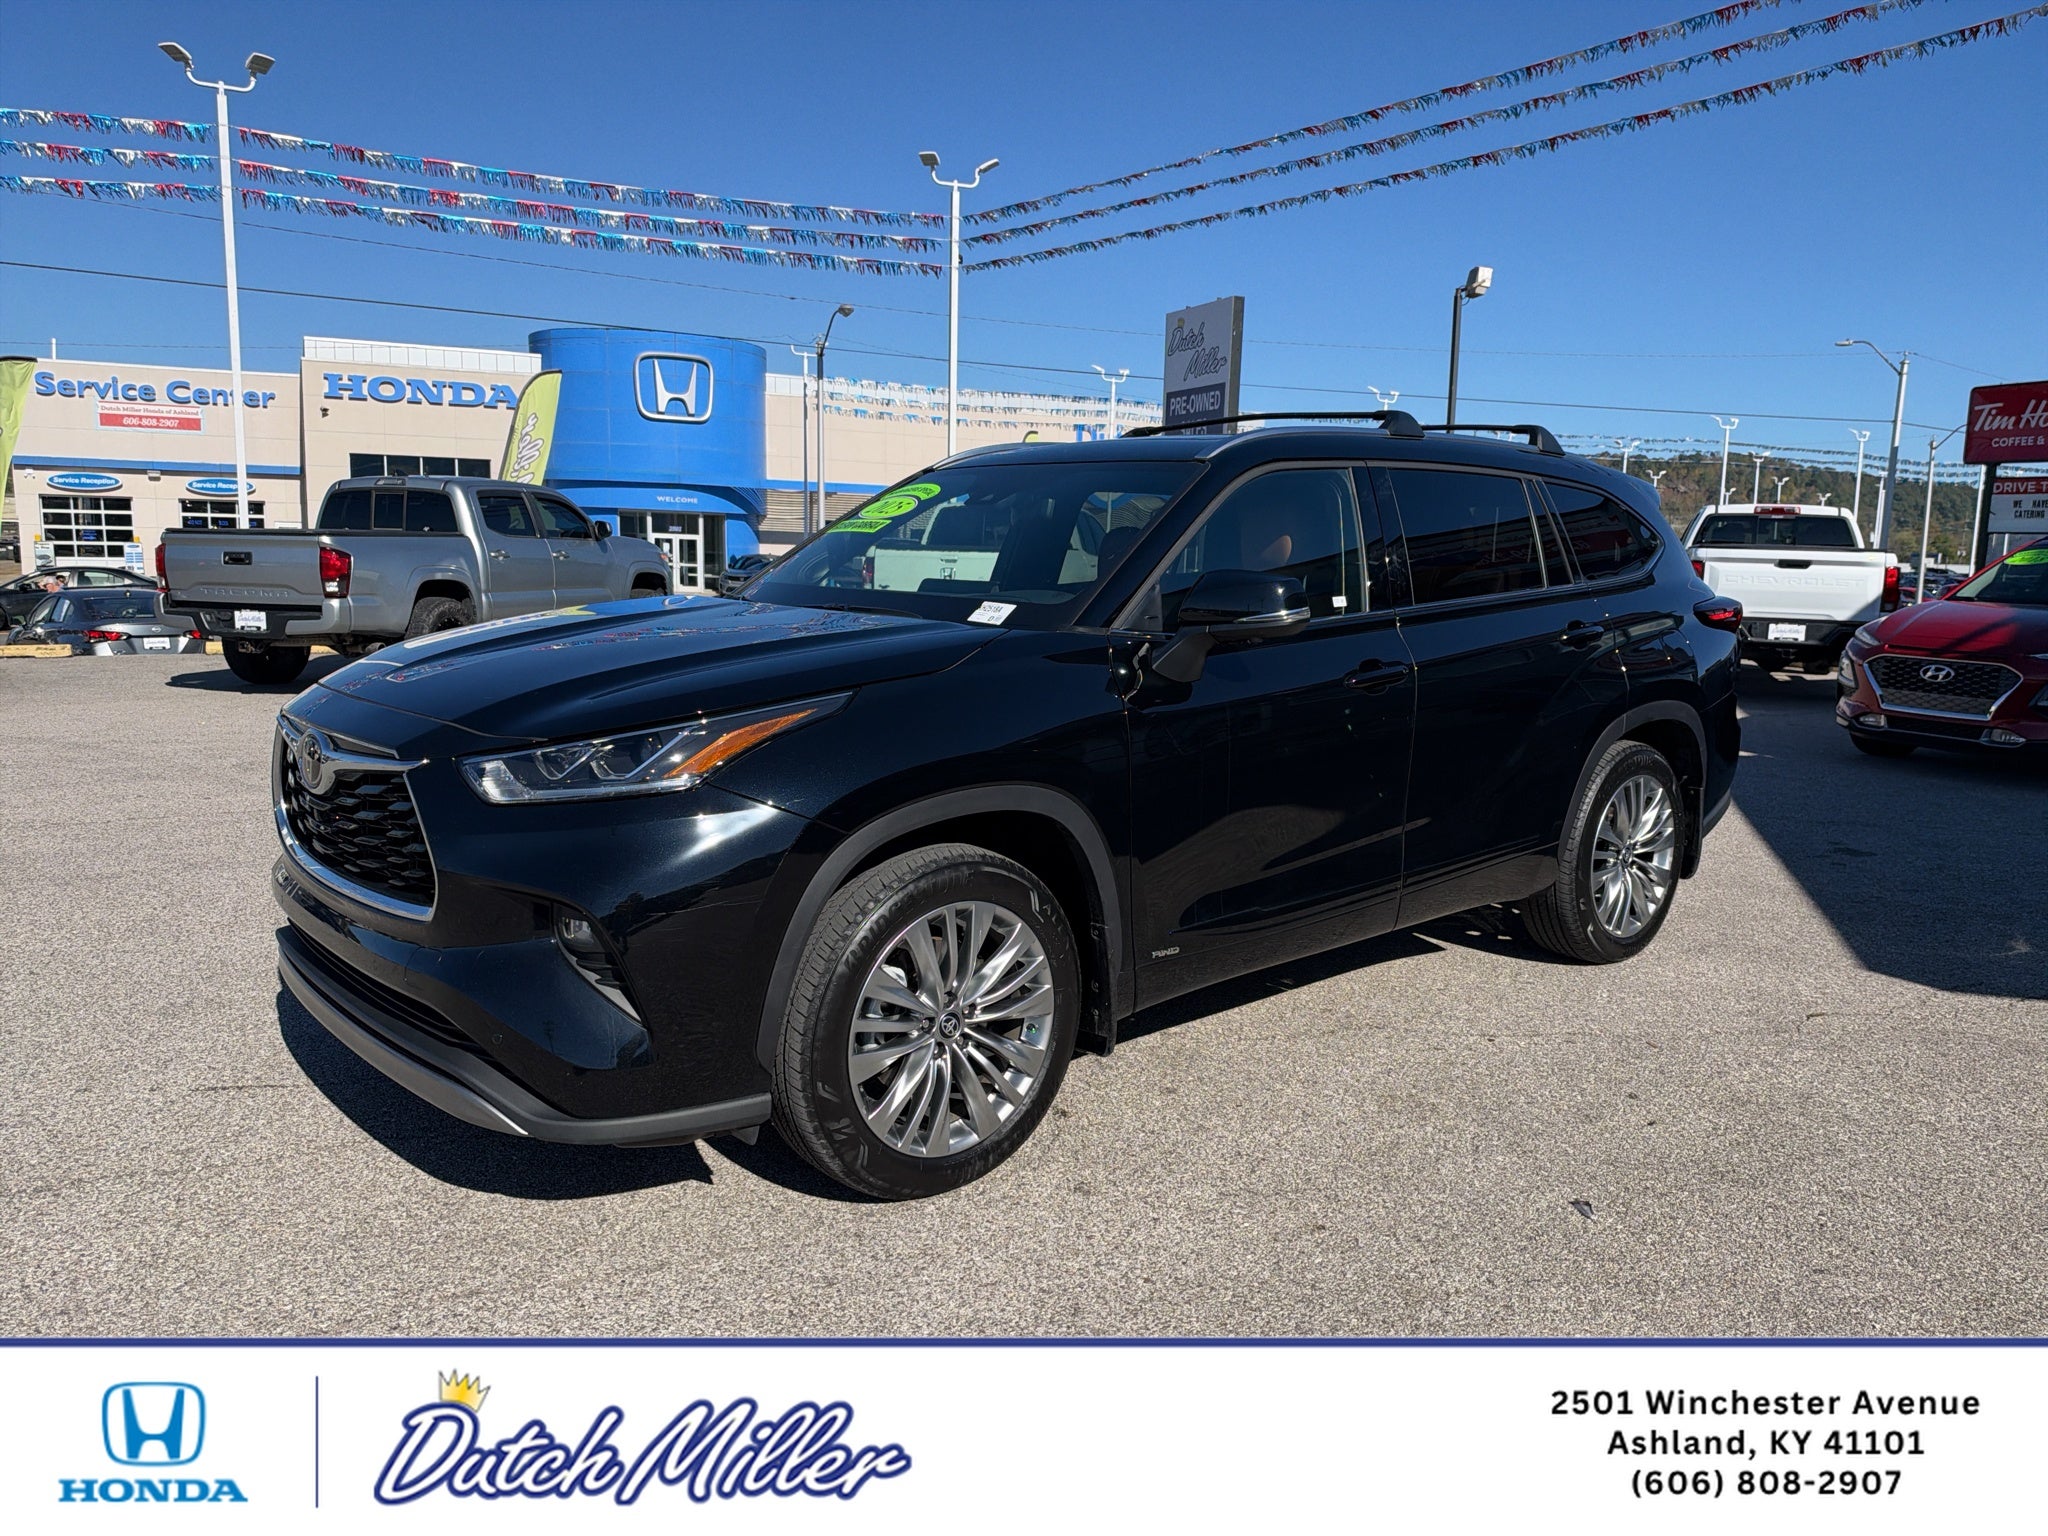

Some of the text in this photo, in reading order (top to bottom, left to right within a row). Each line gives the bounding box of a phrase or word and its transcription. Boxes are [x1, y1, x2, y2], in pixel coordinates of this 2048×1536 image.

[1168, 321, 1205, 357] Dutch
[1184, 346, 1228, 382] Miller
[34, 371, 276, 408] Service Cener
[323, 372, 519, 410] HONDA
[1169, 390, 1221, 417] PRE-OWNED
[123, 416, 179, 428] 606-808-2907
[1974, 402, 2016, 432] Tim
[1991, 435, 2045, 448] COFFEE &
[1993, 481, 2037, 493] DRIVE
[656, 495, 698, 504] WELCOME
[2013, 500, 2022, 508] WE
[2014, 510, 2046, 519] CATERING
[1725, 575, 1865, 587] CHEVROLET
[1152, 946, 1180, 959] AWD
